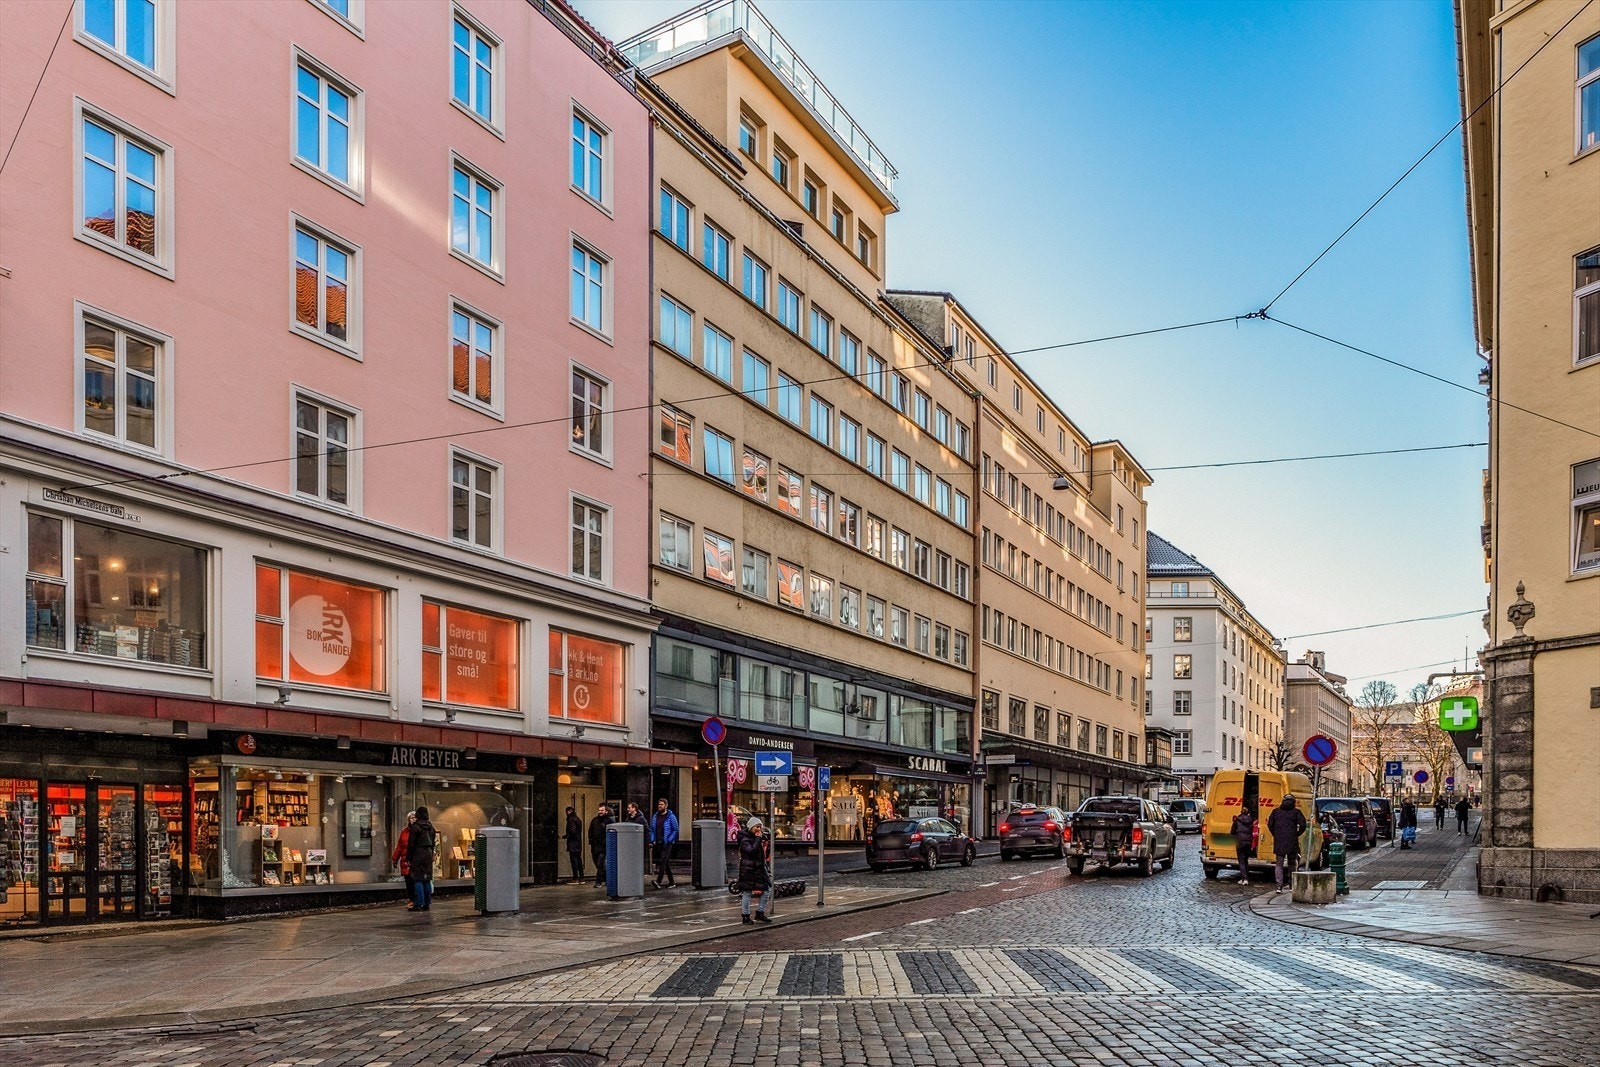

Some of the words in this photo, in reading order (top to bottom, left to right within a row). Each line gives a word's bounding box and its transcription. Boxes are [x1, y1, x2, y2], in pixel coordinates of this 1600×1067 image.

[306, 629, 323, 642] BOK
[449, 623, 476, 641] Gaver
[478, 630, 487, 643] til
[449, 644, 473, 659] store
[475, 650, 487, 664] og
[457, 663, 479, 678] små!
[748, 736, 794, 750] DAVID-ANDERSEN
[391, 746, 417, 766] ARK
[420, 749, 460, 769] BEYER
[908, 756, 948, 774] SCABAL
[1389, 763, 1399, 775] P
